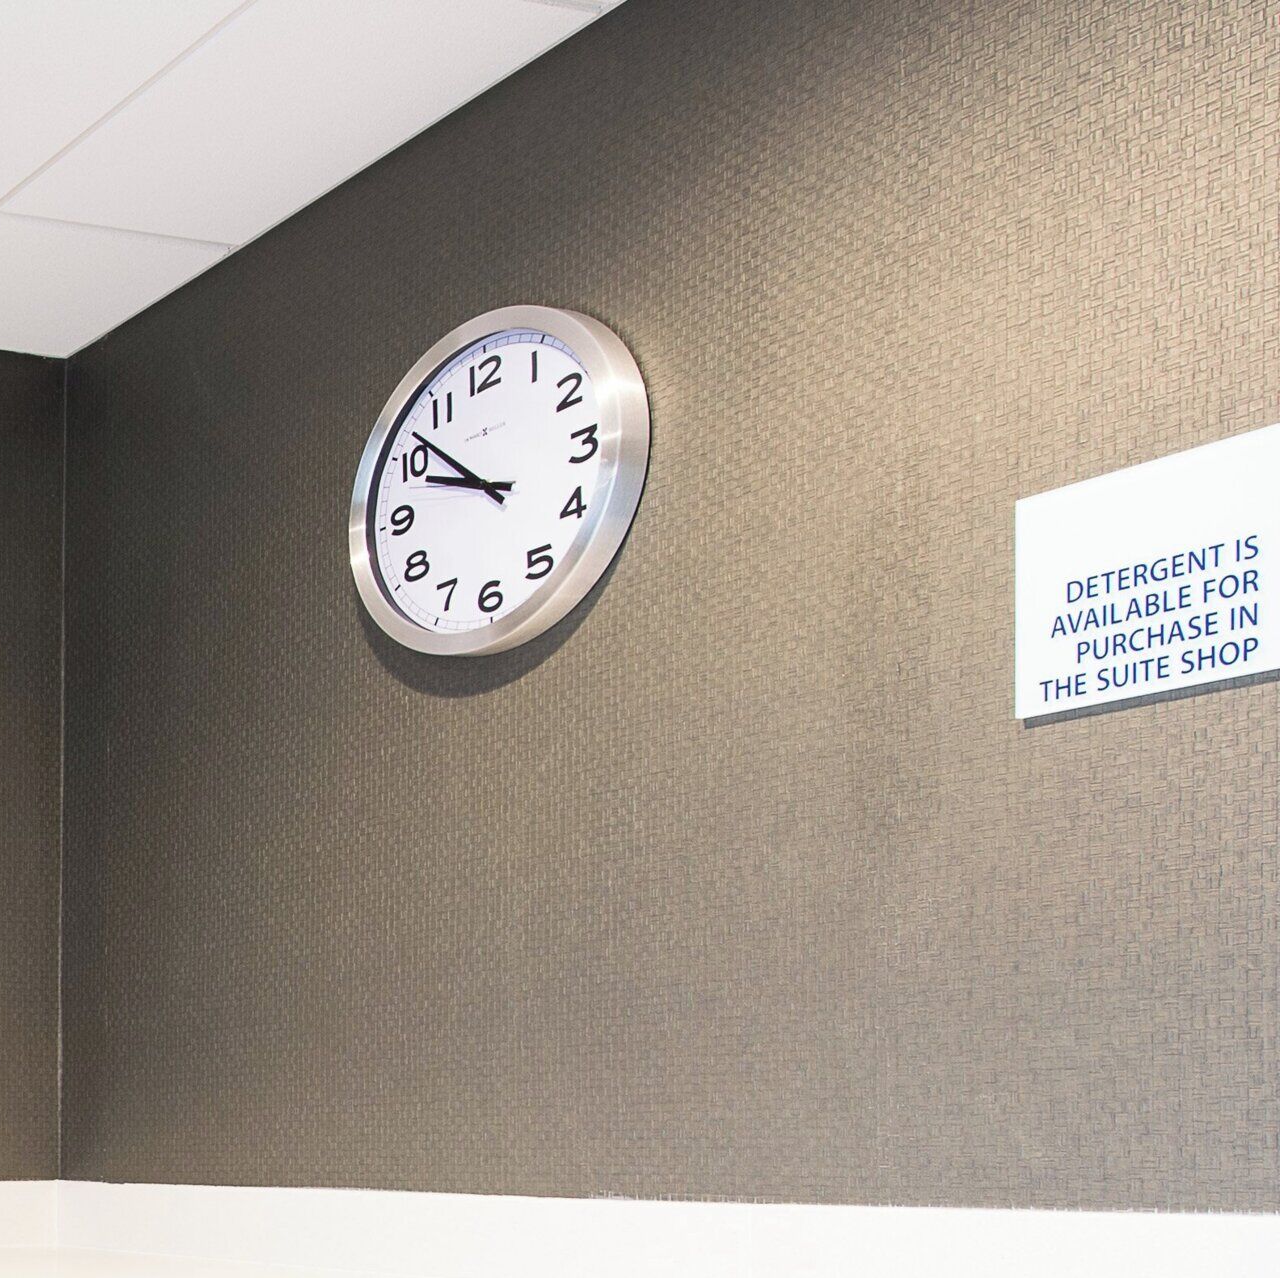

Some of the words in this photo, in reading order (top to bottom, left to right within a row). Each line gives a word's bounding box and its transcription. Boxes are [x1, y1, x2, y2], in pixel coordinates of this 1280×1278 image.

[470, 355, 502, 397] 12
[531, 351, 538, 383] 1
[432, 392, 452, 430] 11
[556, 372, 583, 413] 2
[568, 424, 599, 464] 3
[402, 444, 428, 483] 10
[390, 504, 415, 536] 9
[559, 486, 586, 519] 4
[404, 550, 430, 582] 8
[524, 544, 553, 580] 5
[1066, 543, 1225, 603] DETERGENT
[1236, 535, 1259, 562] IS
[436, 578, 458, 612] 7
[478, 580, 503, 613] 6
[1051, 585, 1191, 638] AVAILABLE
[1204, 570, 1259, 603] FOR
[1077, 612, 1218, 664] PURCHASE
[1231, 602, 1258, 630] IN
[1040, 672, 1087, 702] THE
[1097, 655, 1170, 691] SUITE
[1181, 637, 1259, 674] SHOP
